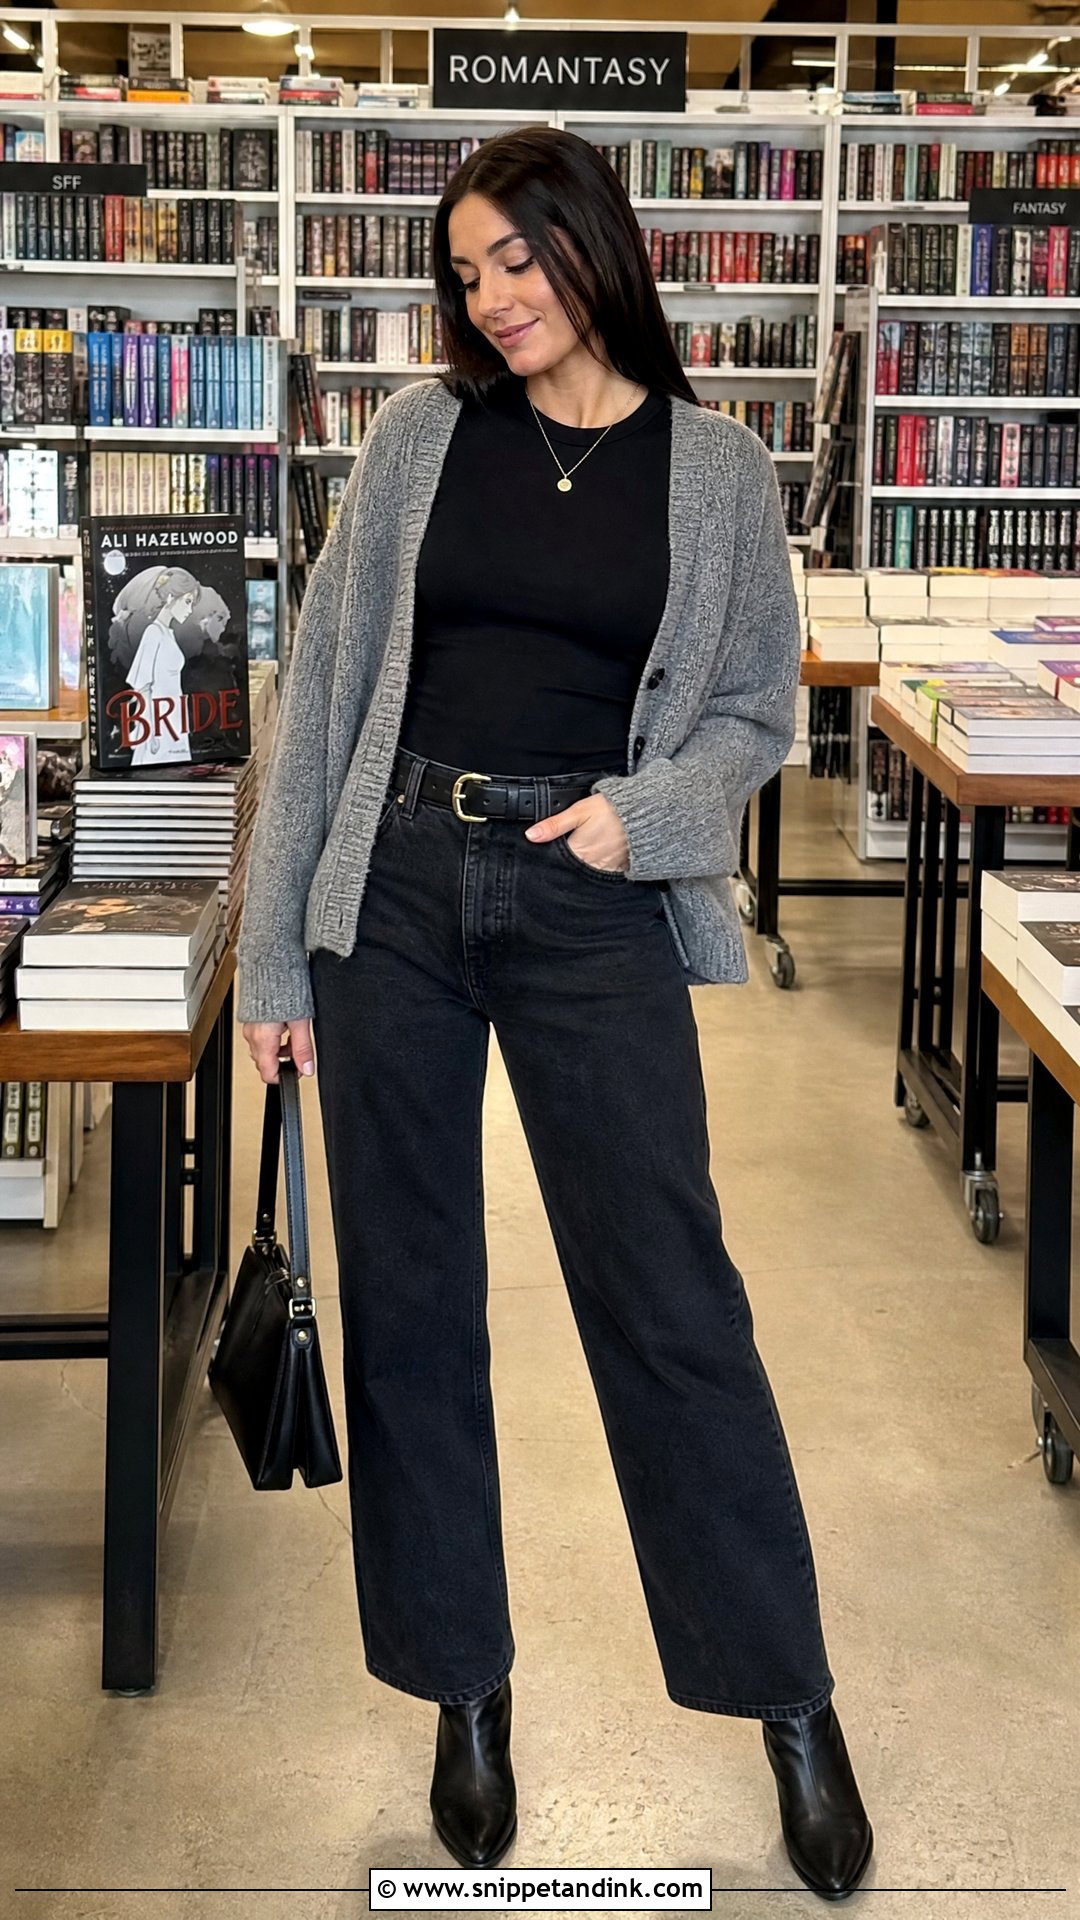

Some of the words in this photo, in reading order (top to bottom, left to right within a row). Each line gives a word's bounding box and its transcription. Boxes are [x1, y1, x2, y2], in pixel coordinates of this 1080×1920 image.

[449, 55, 670, 86] ROMANTASY
[52, 175, 82, 190] SFF
[1013, 202, 1067, 215] FANTASY
[101, 533, 127, 548] ALI
[136, 531, 238, 547] HAZELWOOD
[106, 689, 243, 748] BRIDE
